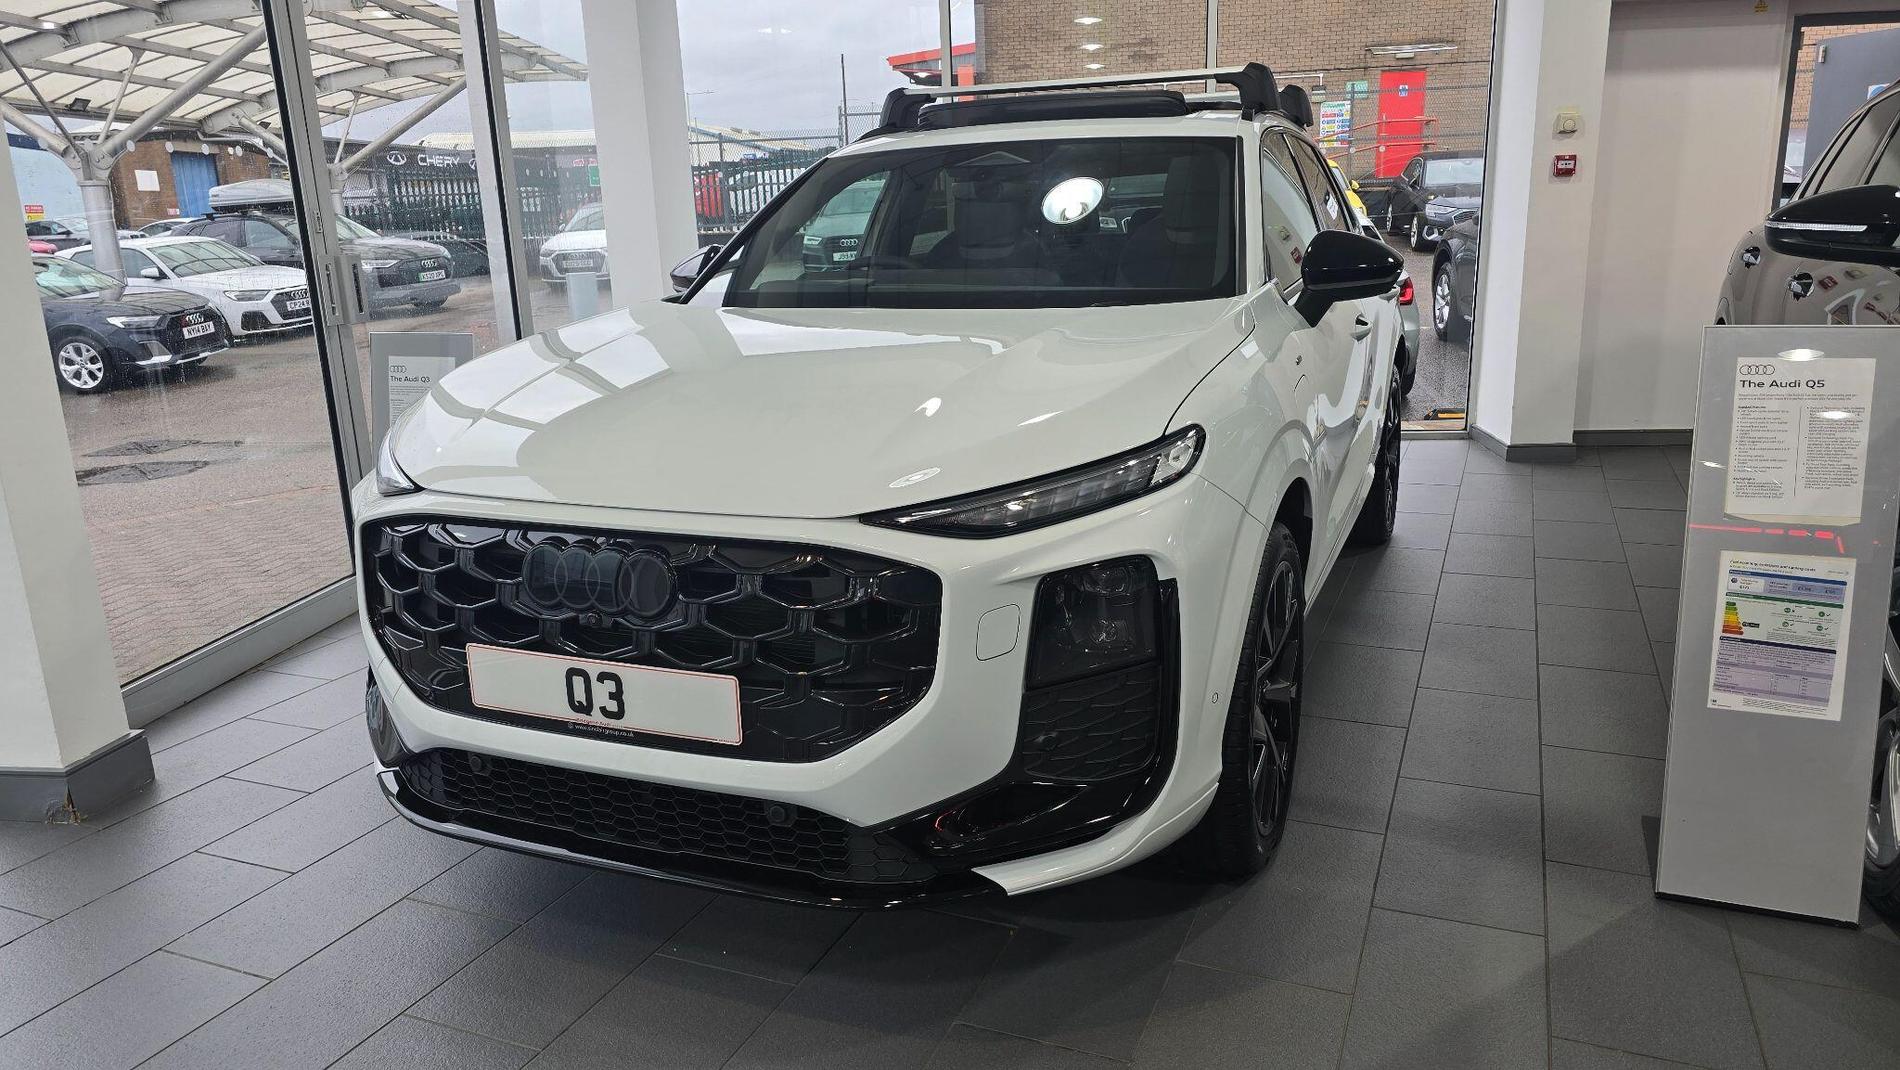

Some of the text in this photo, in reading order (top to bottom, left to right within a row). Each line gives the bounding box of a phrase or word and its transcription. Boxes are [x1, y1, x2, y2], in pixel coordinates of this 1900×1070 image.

[417, 154, 460, 168] CHERY
[1739, 379, 1825, 390] The Audi Q5
[564, 666, 626, 721] Q3
